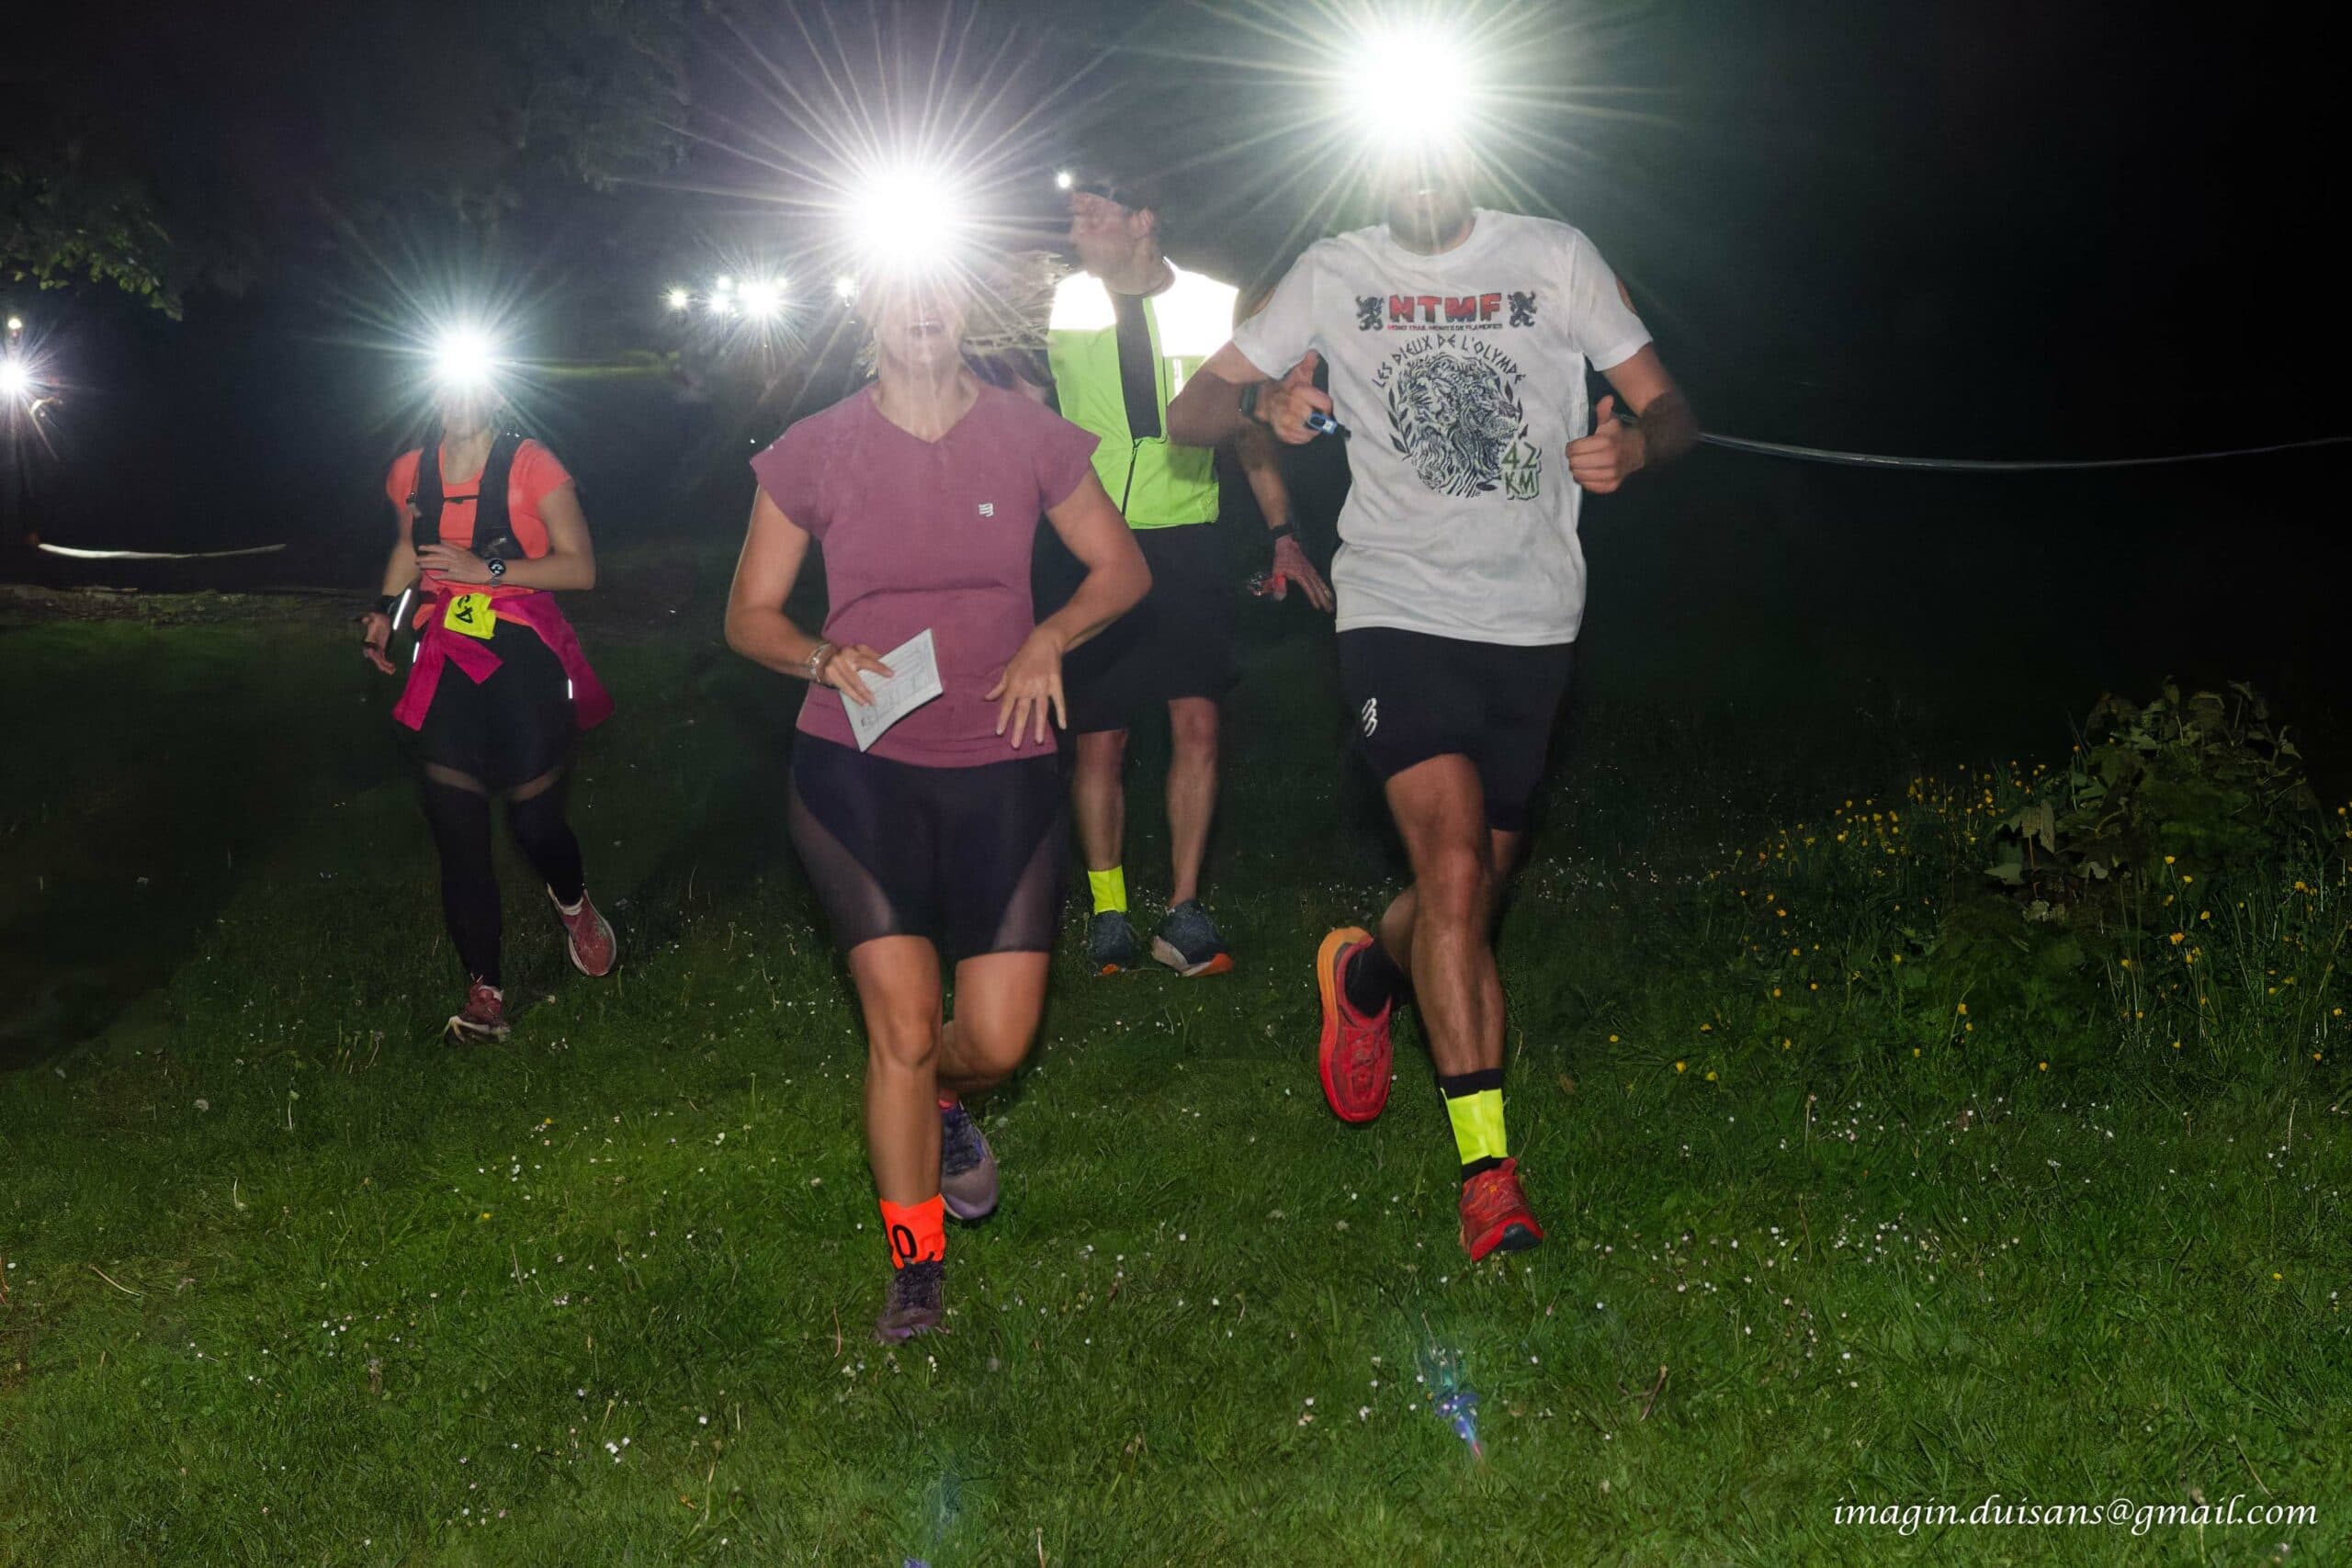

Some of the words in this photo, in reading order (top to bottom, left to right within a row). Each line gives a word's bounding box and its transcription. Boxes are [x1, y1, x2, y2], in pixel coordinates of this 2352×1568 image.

[1389, 292, 1502, 323] NTMF
[1372, 361, 1393, 389] LES
[1391, 334, 1433, 366] DIEUX
[1437, 333, 1456, 349] DE
[1462, 334, 1527, 386] L'OLYMPE
[1501, 441, 1539, 469] 42
[1505, 469, 1538, 498] KM
